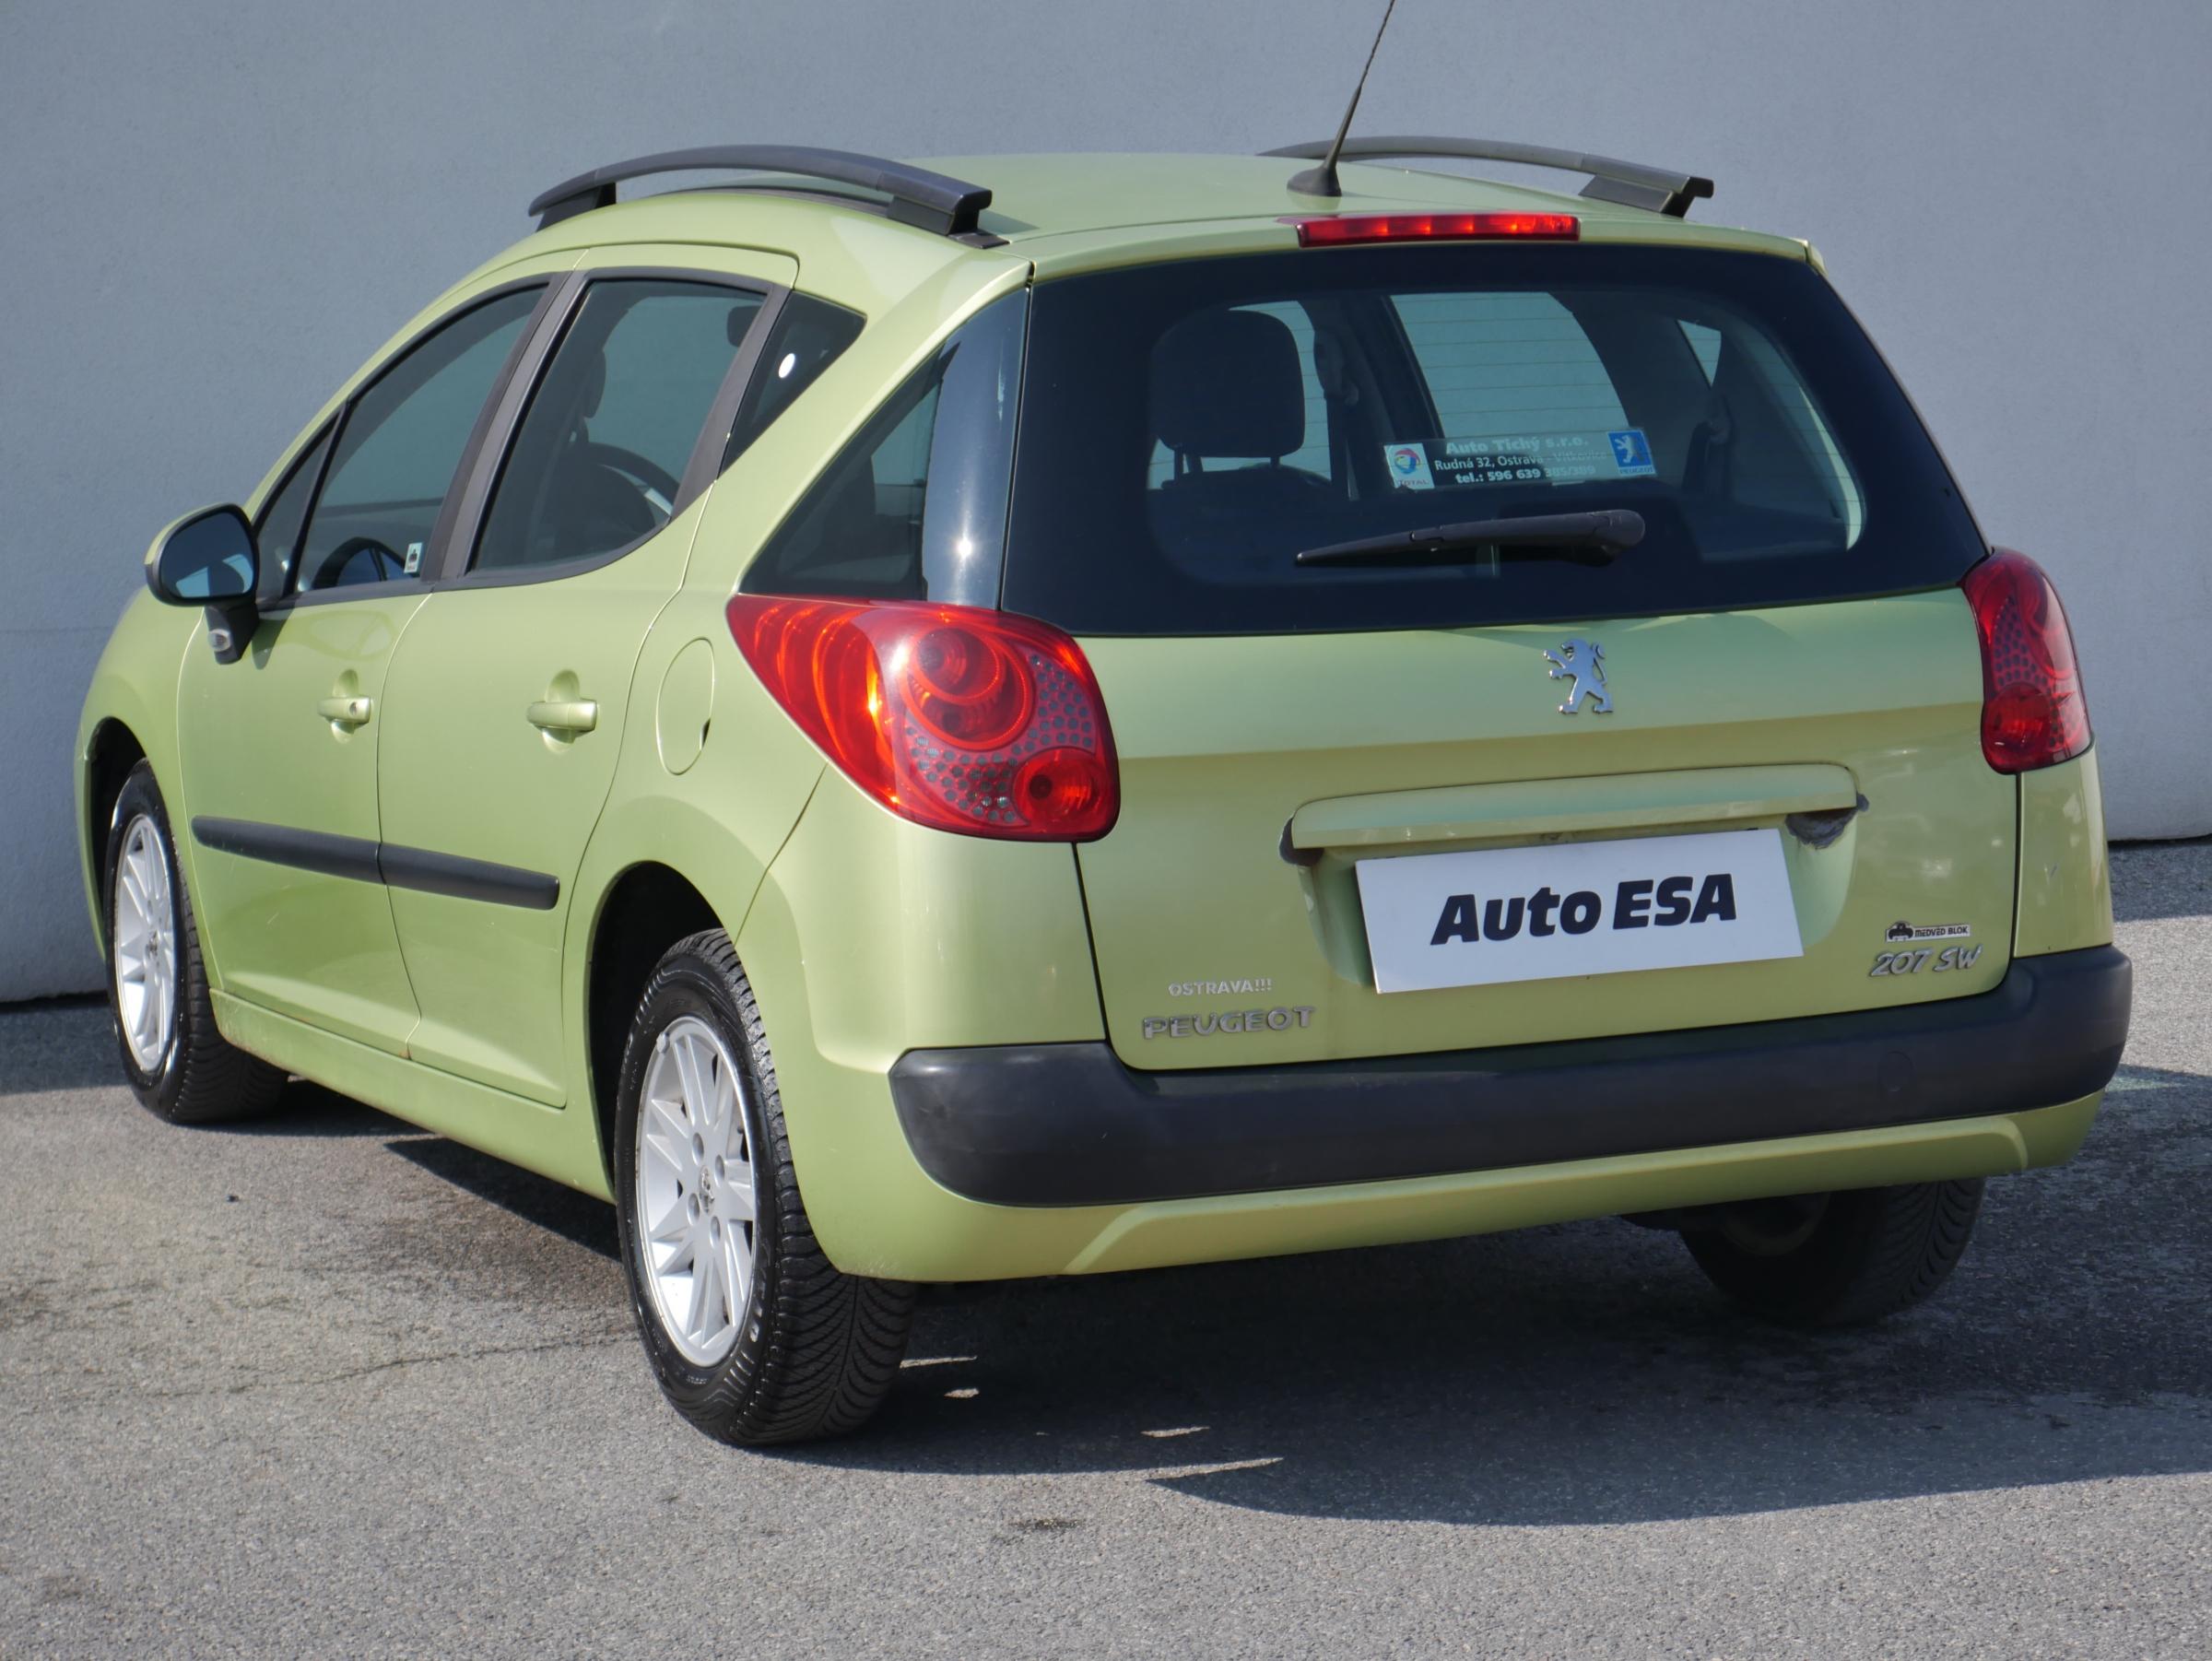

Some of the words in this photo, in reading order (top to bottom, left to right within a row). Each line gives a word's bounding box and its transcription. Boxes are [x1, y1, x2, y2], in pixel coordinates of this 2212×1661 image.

[1445, 442, 1488, 454] Auto
[1491, 437, 1540, 453] Tichý
[1434, 457, 1475, 470] Rudná
[1477, 456, 1495, 469] 32,
[1498, 454, 1544, 465] Ostrava
[1455, 472, 1484, 484] tel.:
[1487, 470, 1512, 482] 596
[1516, 468, 1541, 479] 639
[1430, 887, 1602, 946] Auto
[1612, 873, 1737, 930] ESA
[1947, 925, 1969, 935] BLOK
[1869, 948, 1934, 977] 207
[1934, 944, 1984, 972] SW
[1168, 978, 1273, 997] OSTRAVA!!!
[1142, 1006, 1315, 1041] PEUGEOT
